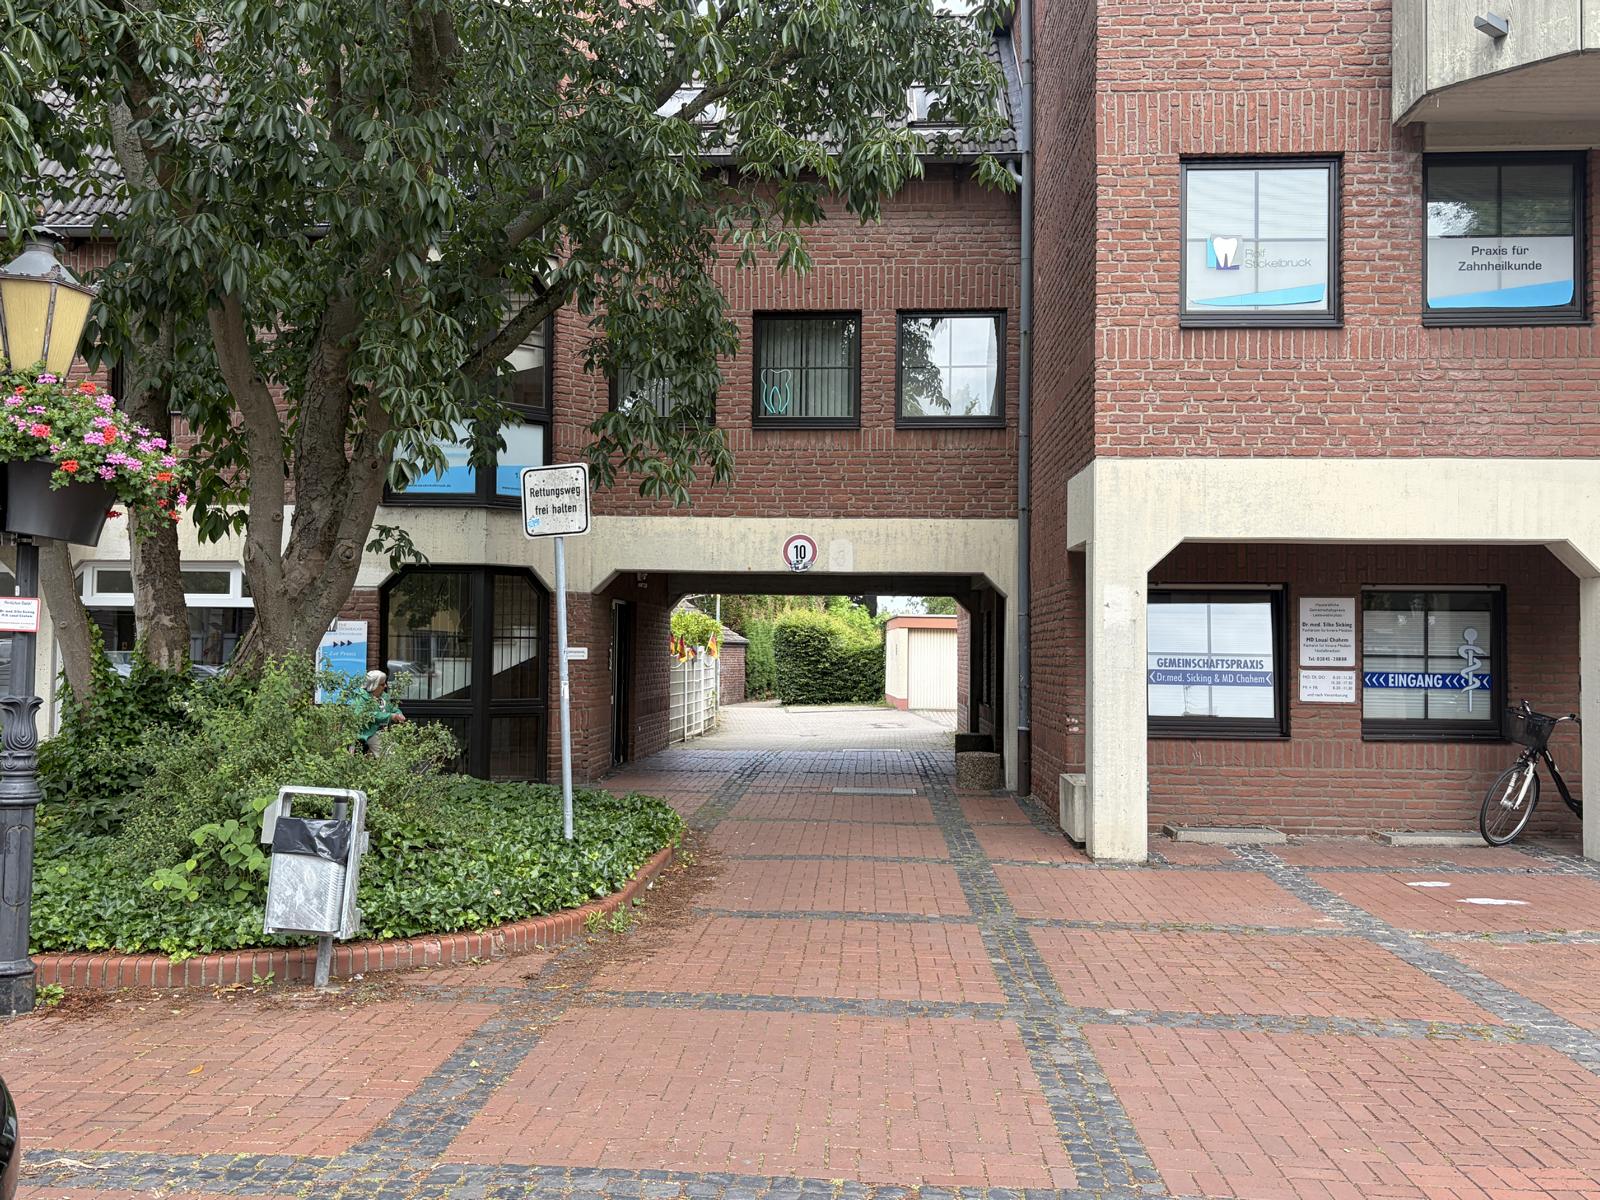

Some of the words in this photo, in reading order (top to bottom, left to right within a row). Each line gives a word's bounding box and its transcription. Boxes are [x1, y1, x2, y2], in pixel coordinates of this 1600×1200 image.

[1471, 245, 1508, 256] Praxis
[1512, 245, 1530, 255] für
[1458, 260, 1543, 271] Zahnheilkunde
[530, 486, 581, 498] Rettungsweg
[535, 504, 549, 516] frei
[552, 503, 577, 514] halten
[793, 544, 807, 560] 10
[1156, 657, 1264, 670] GEMEINSCHAFTSPRAXIS
[1186, 672, 1212, 685] Sicking
[1214, 673, 1220, 683] &
[1222, 673, 1234, 683] MD
[1388, 673, 1443, 688] EINGANG
